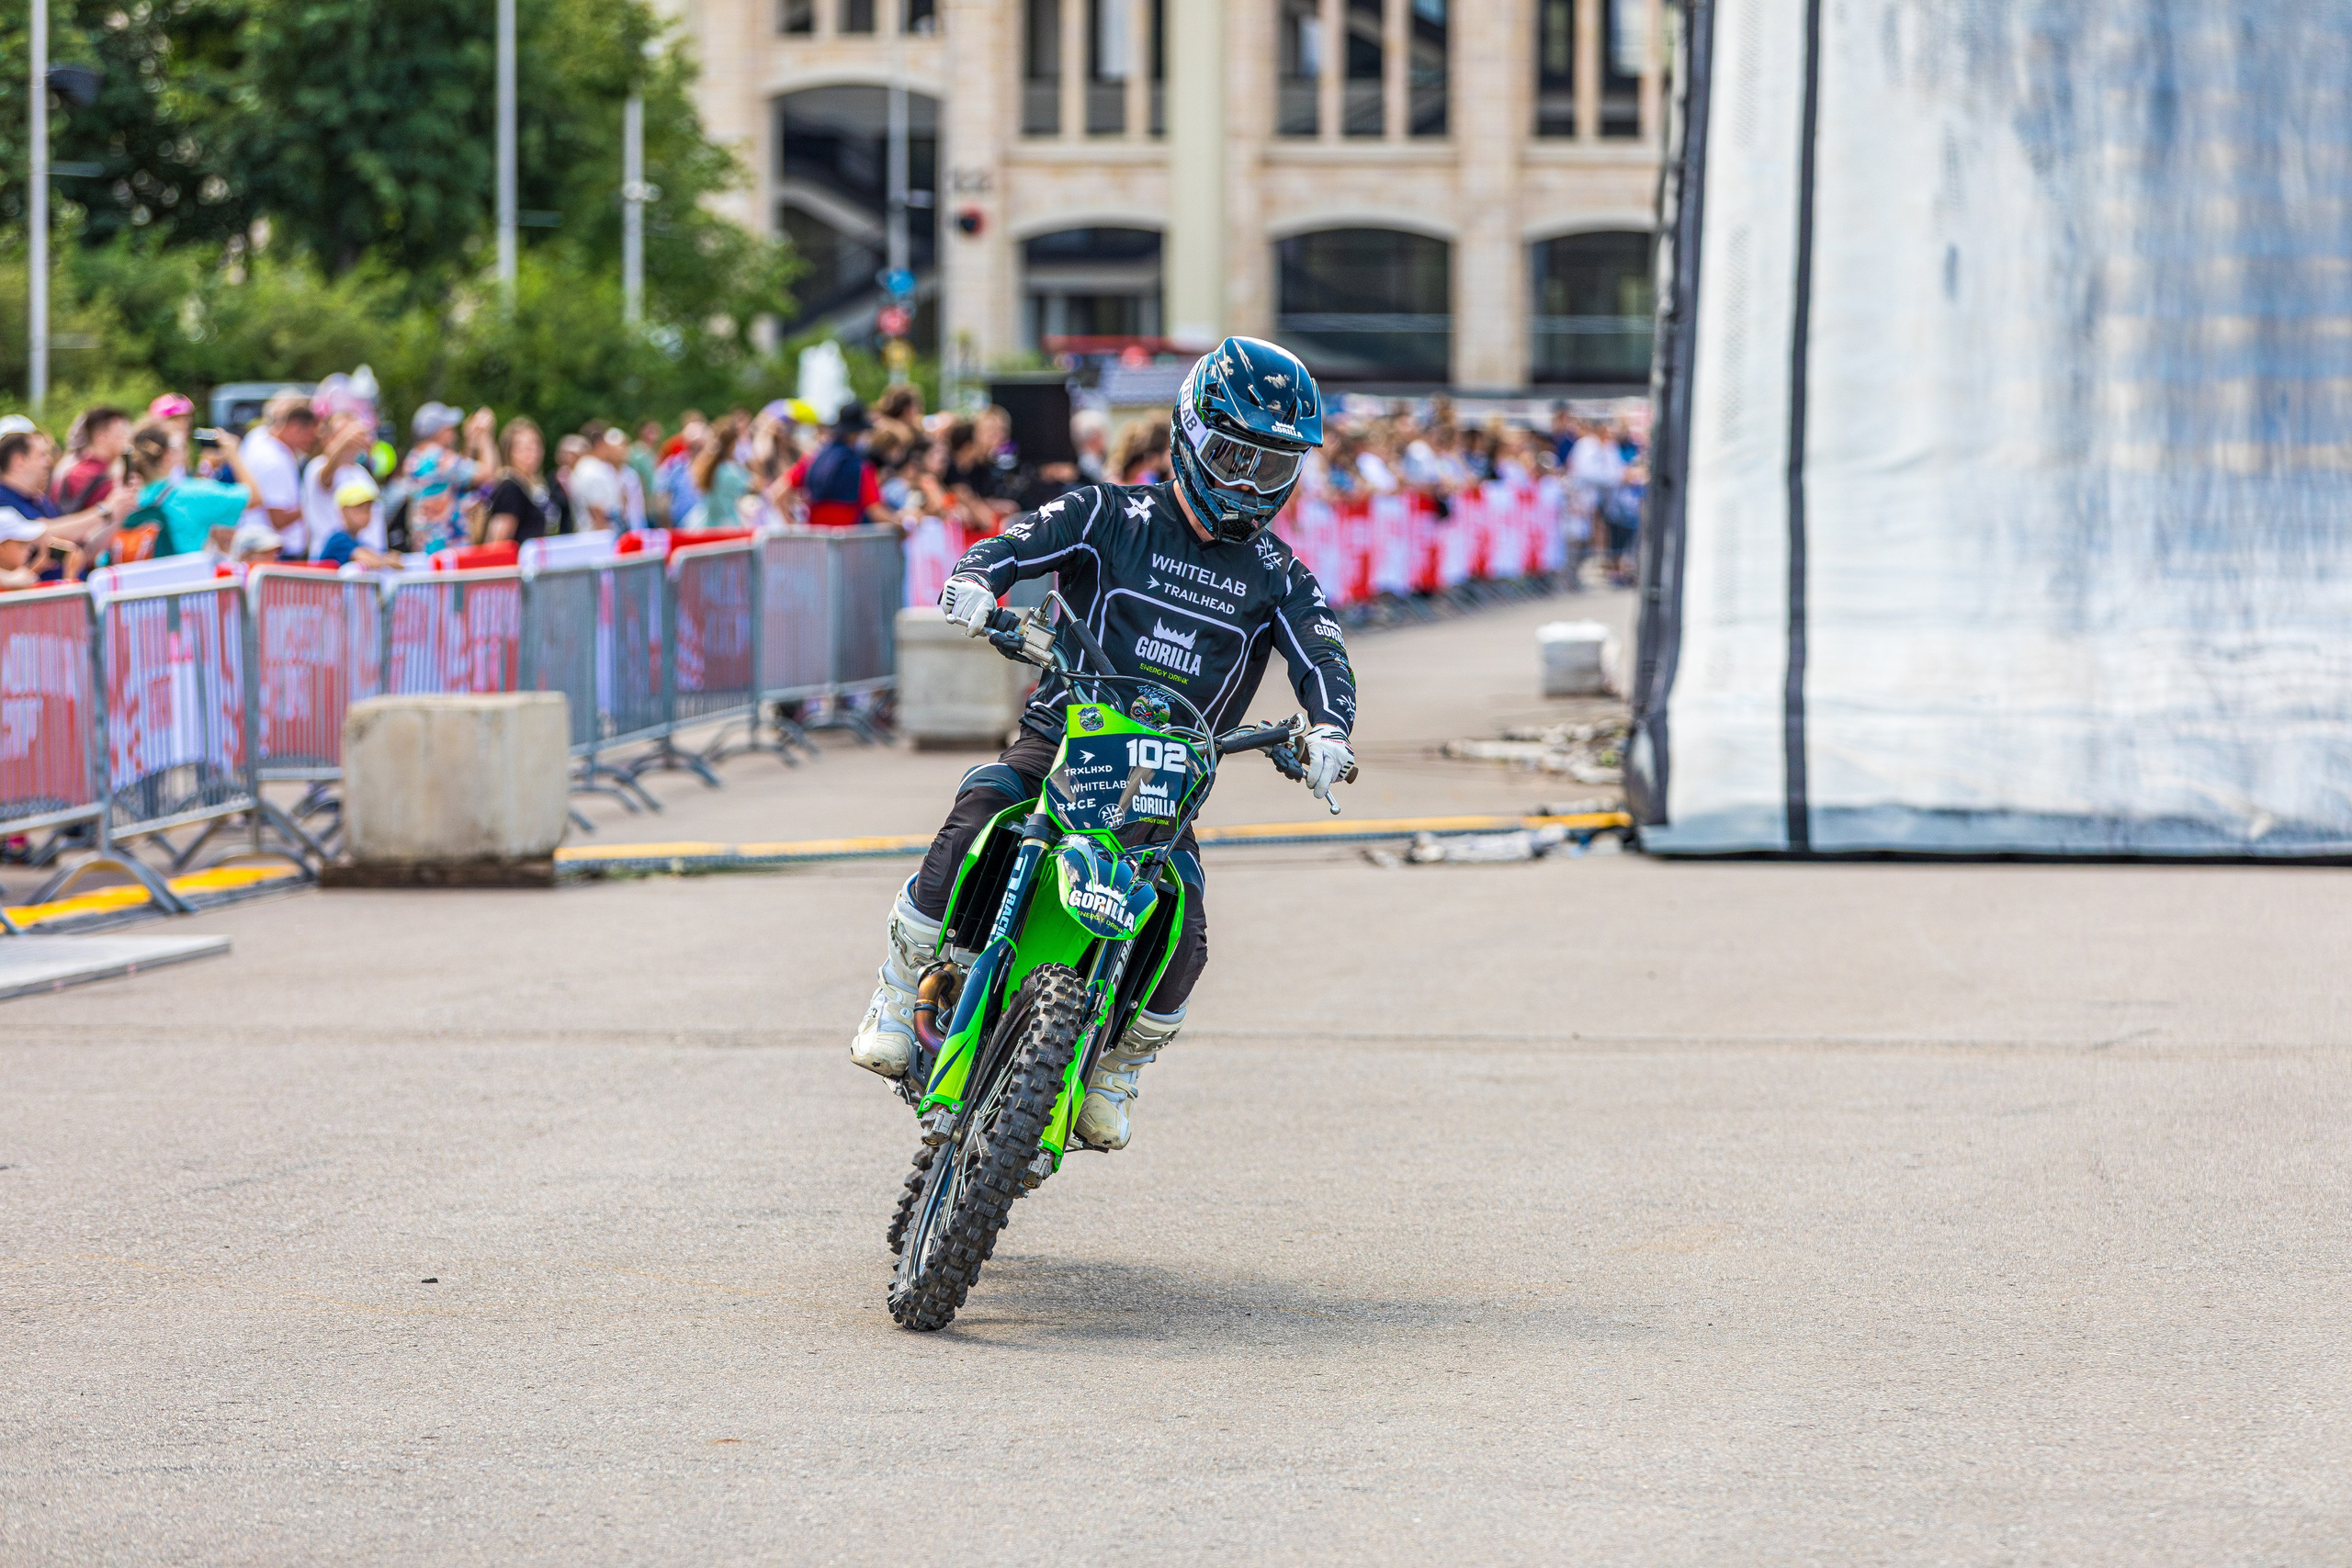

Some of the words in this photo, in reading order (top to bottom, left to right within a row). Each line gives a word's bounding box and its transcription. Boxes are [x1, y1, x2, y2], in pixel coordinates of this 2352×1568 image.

[1271, 424, 1304, 439] GORILLA
[1151, 552, 1248, 597] WHITELAB
[1163, 582, 1236, 615] TRAILHEAD
[1134, 635, 1203, 677] GORILLA
[1138, 662, 1168, 678] ENERGY
[1167, 671, 1190, 685] DRINK
[1125, 738, 1187, 773] 102
[1069, 781, 1127, 794] WHITELAB
[1132, 795, 1177, 818] GORILLA
[1138, 816, 1157, 825] ENERGY
[1068, 889, 1136, 935] GORILLA
[1076, 909, 1105, 923] ENERGY
[1105, 920, 1125, 935] DRINK
